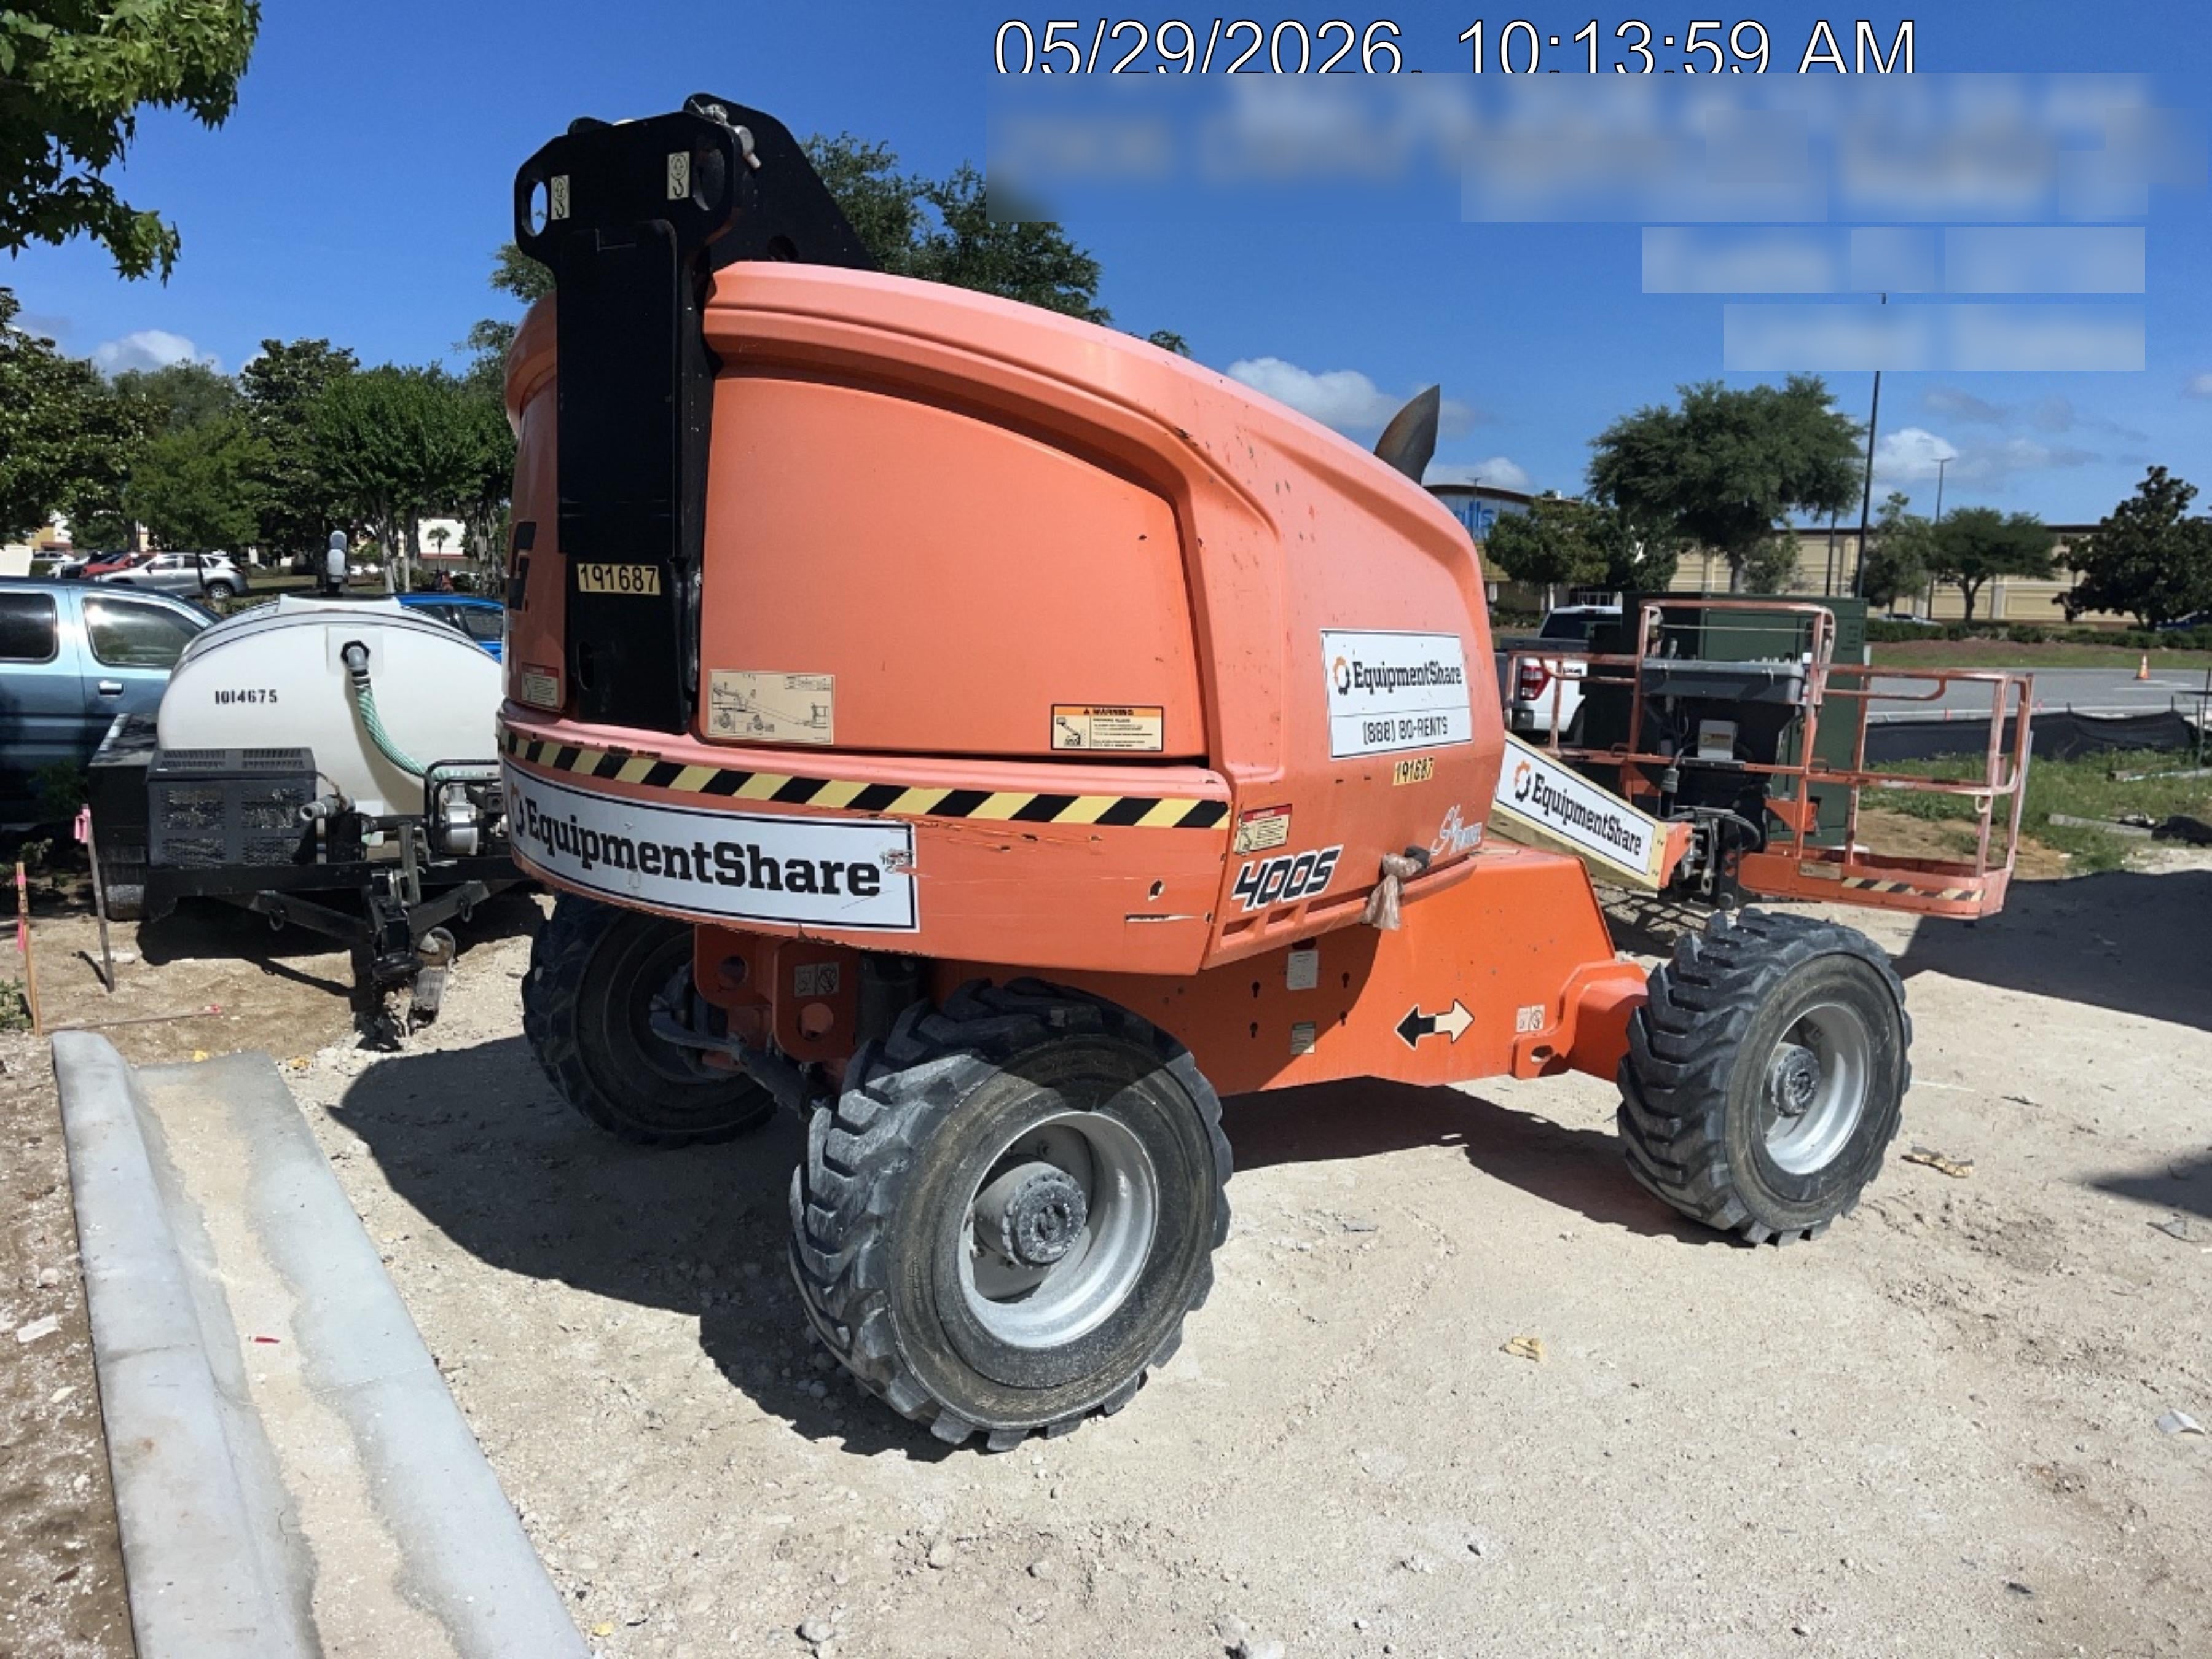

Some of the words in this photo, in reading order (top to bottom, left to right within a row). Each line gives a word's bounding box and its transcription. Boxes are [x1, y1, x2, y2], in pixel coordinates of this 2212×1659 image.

[580, 564, 657, 592] 191687
[1352, 660, 1462, 695] EquipmentShare
[215, 689, 277, 705] 1014675
[1362, 719, 1395, 745] (888)
[1398, 716, 1448, 740] 80-RENTS
[1396, 757, 1435, 783] 191687
[1531, 772, 1642, 856] EquipmentShare
[525, 796, 880, 897] EquipmentShare
[1232, 845, 1344, 912] 400S
